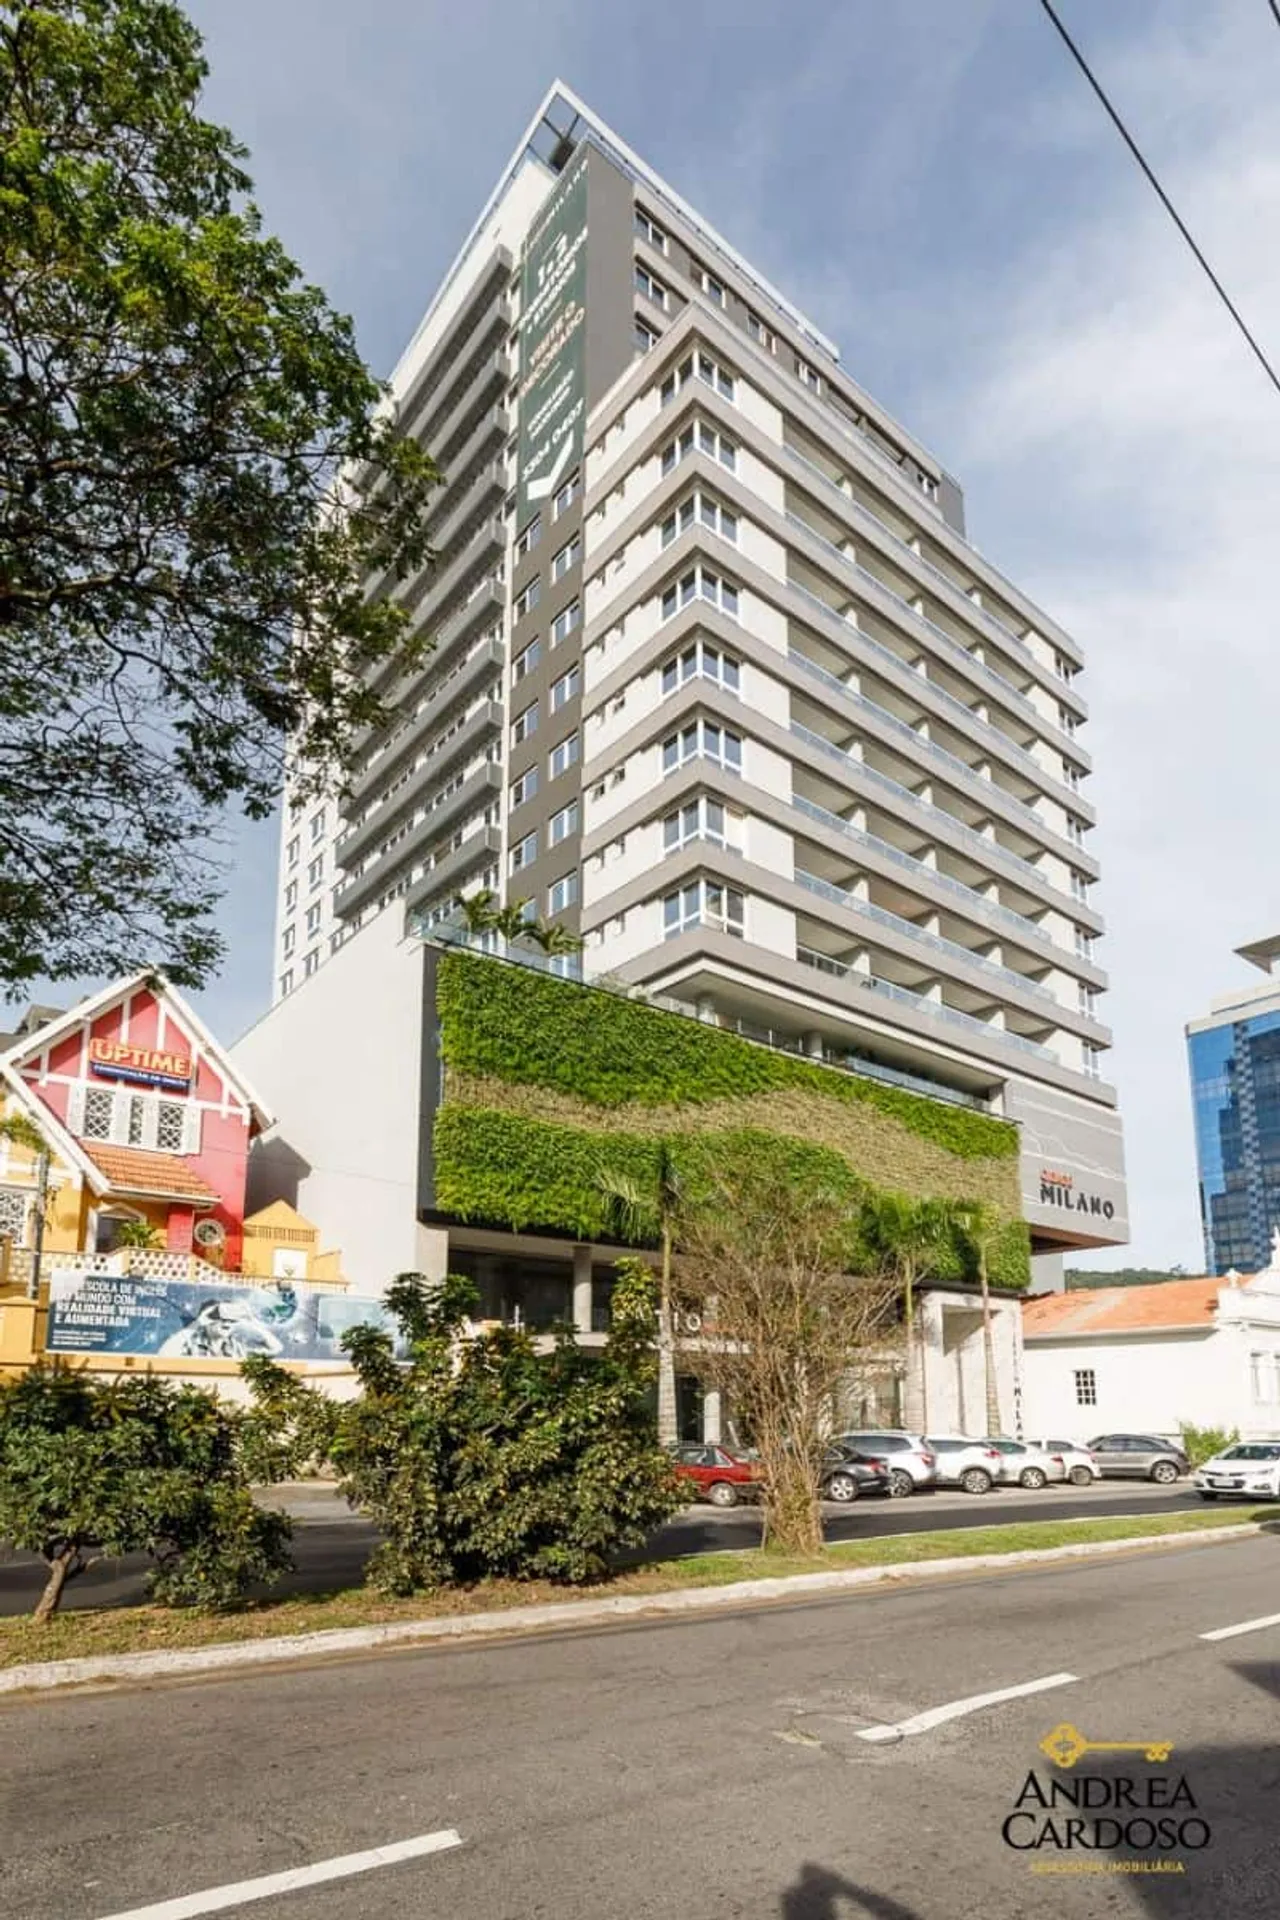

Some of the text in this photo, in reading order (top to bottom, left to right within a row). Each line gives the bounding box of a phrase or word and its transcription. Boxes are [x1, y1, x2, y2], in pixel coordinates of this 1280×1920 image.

[95, 1040, 187, 1075] UPTIME
[1040, 1184, 1115, 1219] MILANO
[56, 1302, 117, 1313] REALIDADE
[64, 1313, 130, 1327] AUMENTADA
